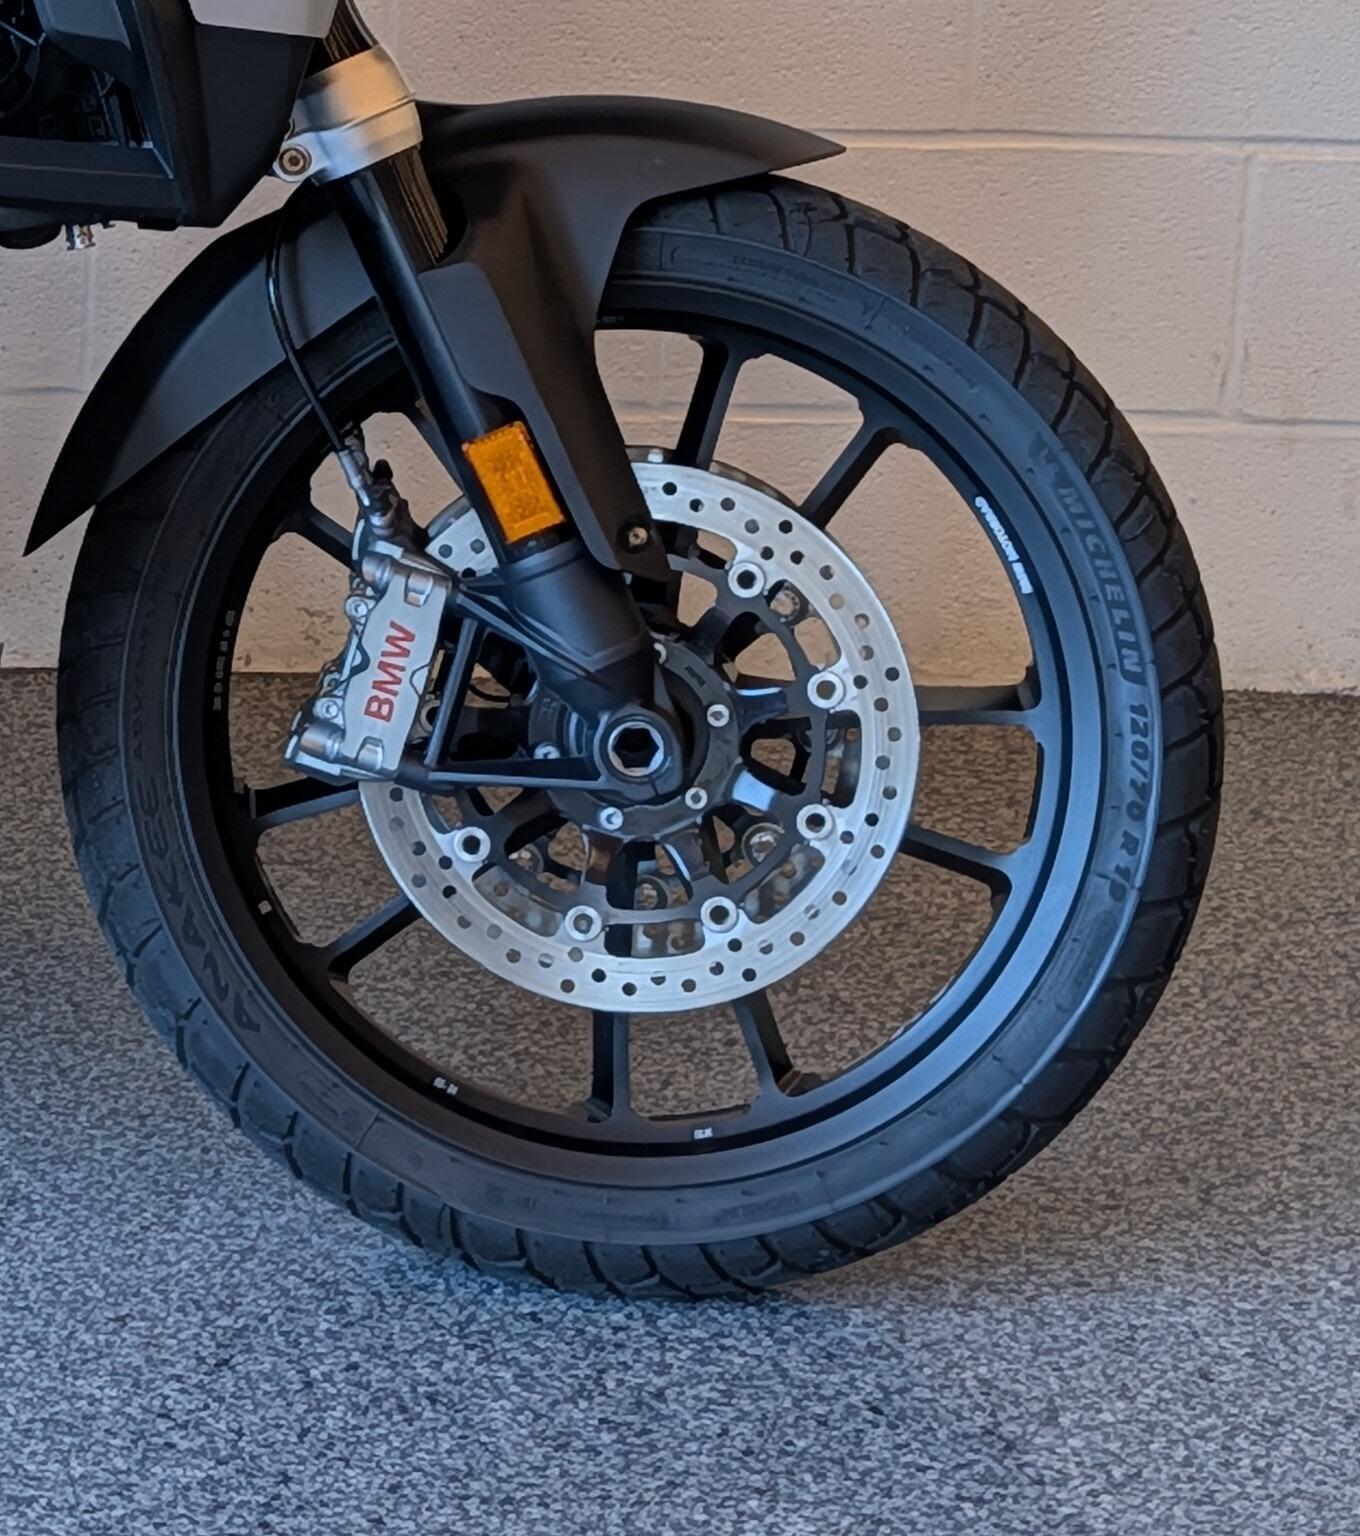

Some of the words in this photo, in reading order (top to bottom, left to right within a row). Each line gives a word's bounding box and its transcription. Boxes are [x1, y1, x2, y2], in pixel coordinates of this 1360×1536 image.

[1058, 486, 1143, 674] MICHELIN
[363, 619, 416, 722] BMW
[1126, 703, 1150, 822] 120/70
[1119, 830, 1140, 857] R
[136, 776, 262, 1033] ANAKEE
